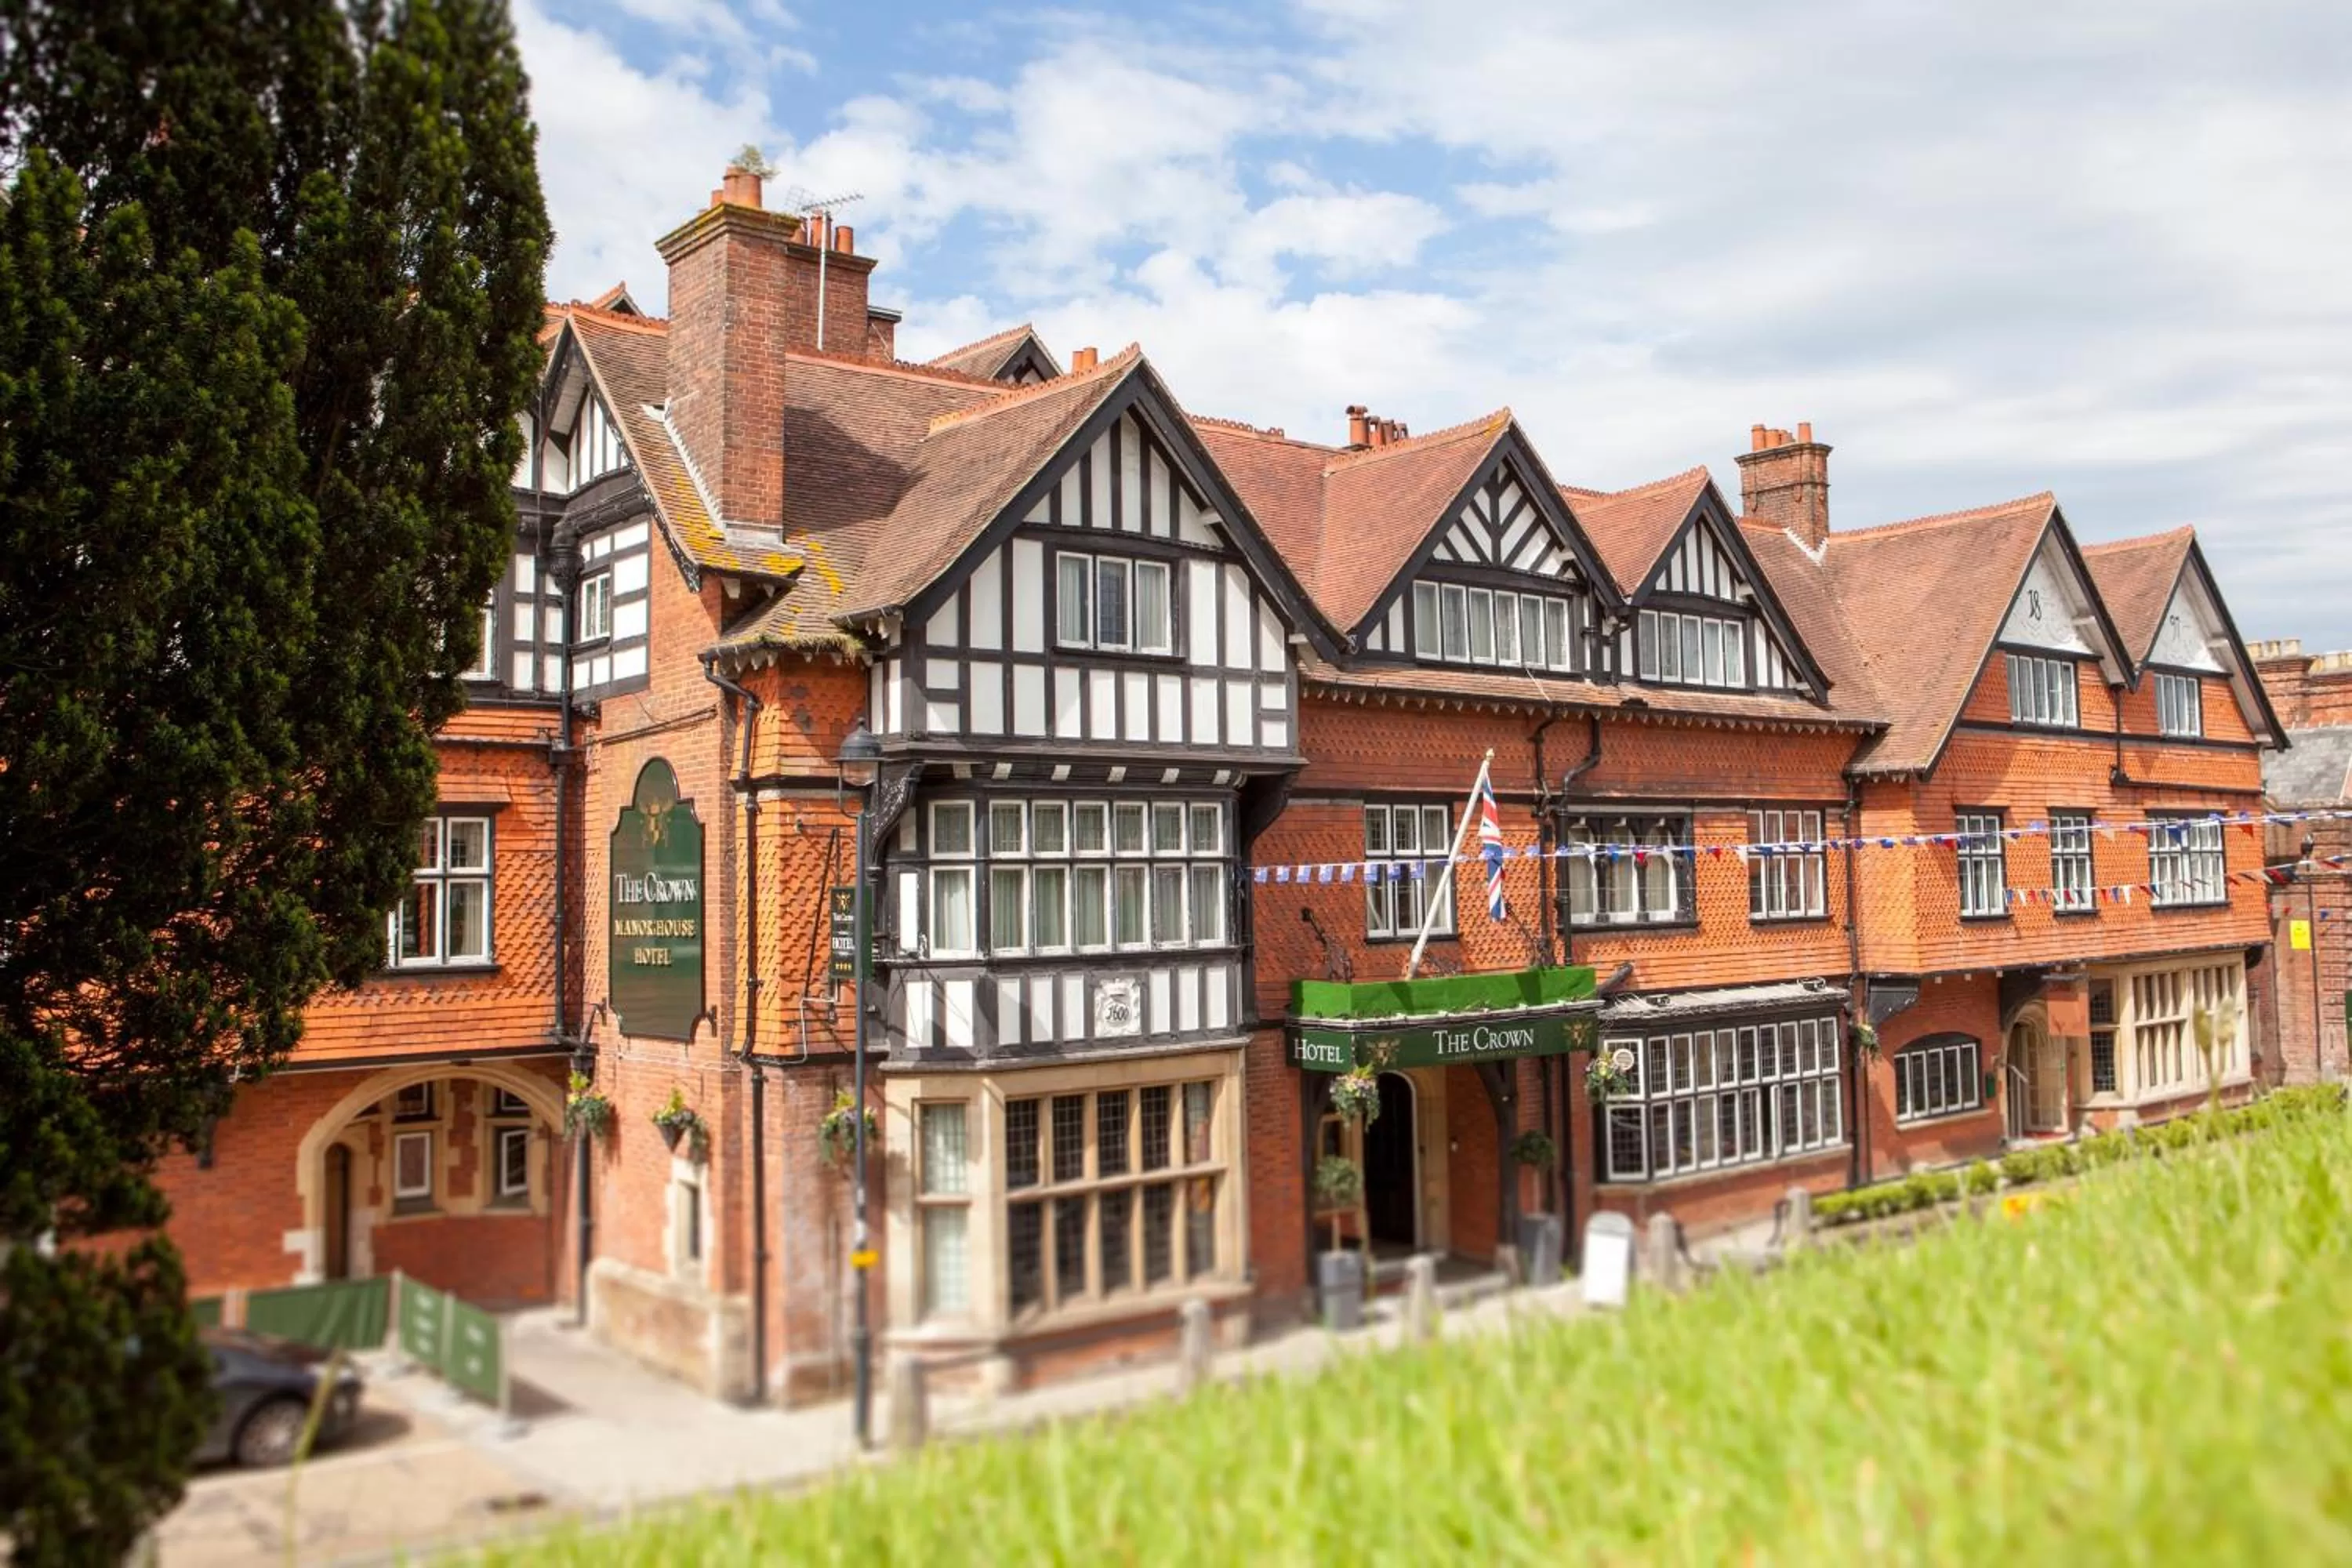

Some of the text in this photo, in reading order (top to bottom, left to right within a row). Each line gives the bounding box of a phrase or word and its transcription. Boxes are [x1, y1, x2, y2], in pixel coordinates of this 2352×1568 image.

[2027, 589, 2042, 621] 18
[615, 872, 697, 902] THE CROWN
[656, 919, 696, 938] HOUSE
[634, 947, 672, 966] HOTEL
[832, 937, 855, 950] HOTEL
[1294, 1037, 1344, 1063] HOTEL
[1432, 1029, 1470, 1054] THE
[1473, 1025, 1534, 1051] CROWN
